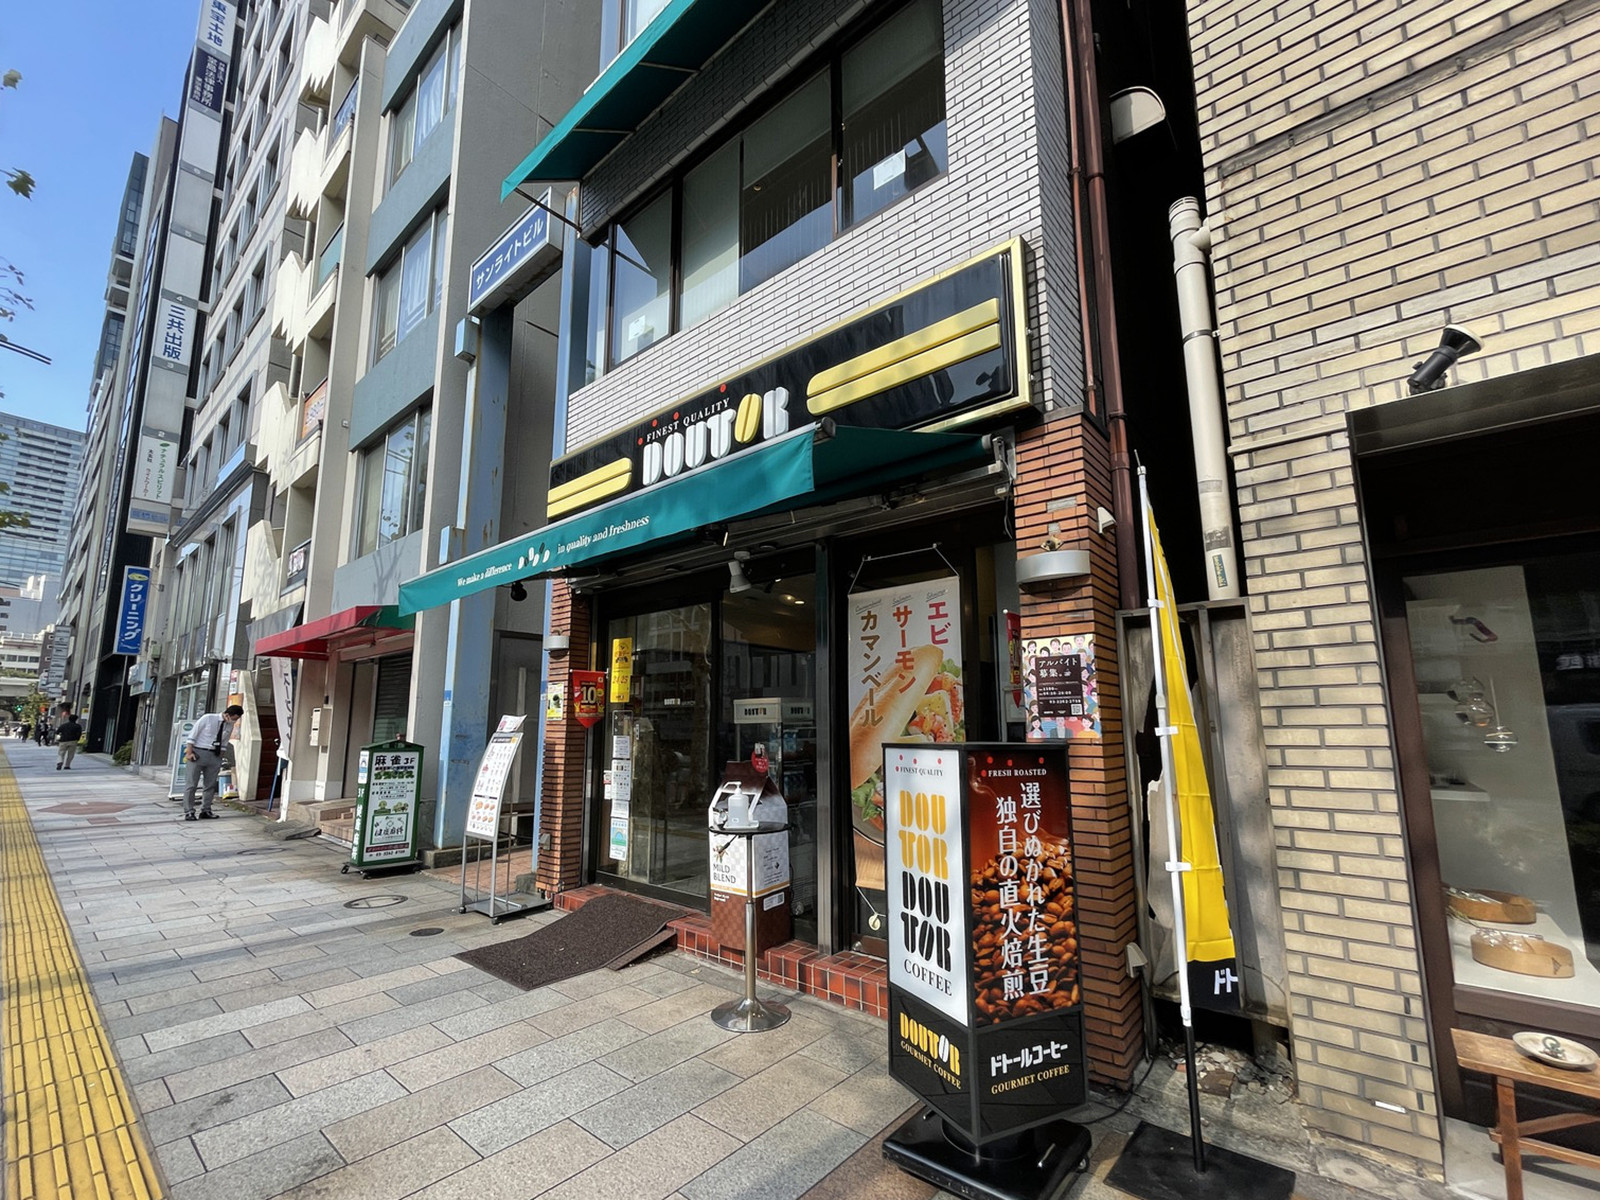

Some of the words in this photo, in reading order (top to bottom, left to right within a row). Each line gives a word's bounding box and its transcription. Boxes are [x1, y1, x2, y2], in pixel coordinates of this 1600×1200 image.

[476, 218, 544, 290] サンライトビル
[163, 304, 186, 361] 三共出版
[642, 386, 790, 486] DOUTOR
[646, 421, 680, 443] FINEST
[683, 397, 730, 427] QUALITY
[557, 543, 565, 555] in
[566, 535, 592, 553] quality
[592, 526, 608, 543] and
[608, 515, 651, 537] freshness
[484, 562, 513, 579] difference
[124, 584, 144, 640] クリーニング
[927, 601, 951, 646] エビ
[860, 610, 884, 728] カマンベール
[892, 605, 916, 694] サーモン
[1039, 658, 1077, 668] アルバイト
[580, 686, 597, 704] 10
[375, 755, 401, 766] 麻雀
[404, 757, 416, 765] 3F
[900, 766, 918, 774] FINEST
[918, 767, 944, 776] QUALITY
[988, 769, 1012, 777] FRESH
[1013, 768, 1047, 776] ROASTED
[713, 863, 730, 873] MILD
[713, 872, 737, 883] BLEND
[1020, 781, 1051, 996] 選びぬかれた生豆
[995, 796, 1025, 1002] 独自の直火焙煎
[904, 958, 953, 997] COFFEE
[900, 1012, 961, 1076] DOUTOR
[900, 1040, 932, 1069] GOURMET
[933, 1062, 962, 1090] COFFEE
[990, 1041, 1068, 1077] ドトールコーヒー
[991, 1074, 1035, 1095] GOURMET
[1037, 1064, 1070, 1081] COFFEE
